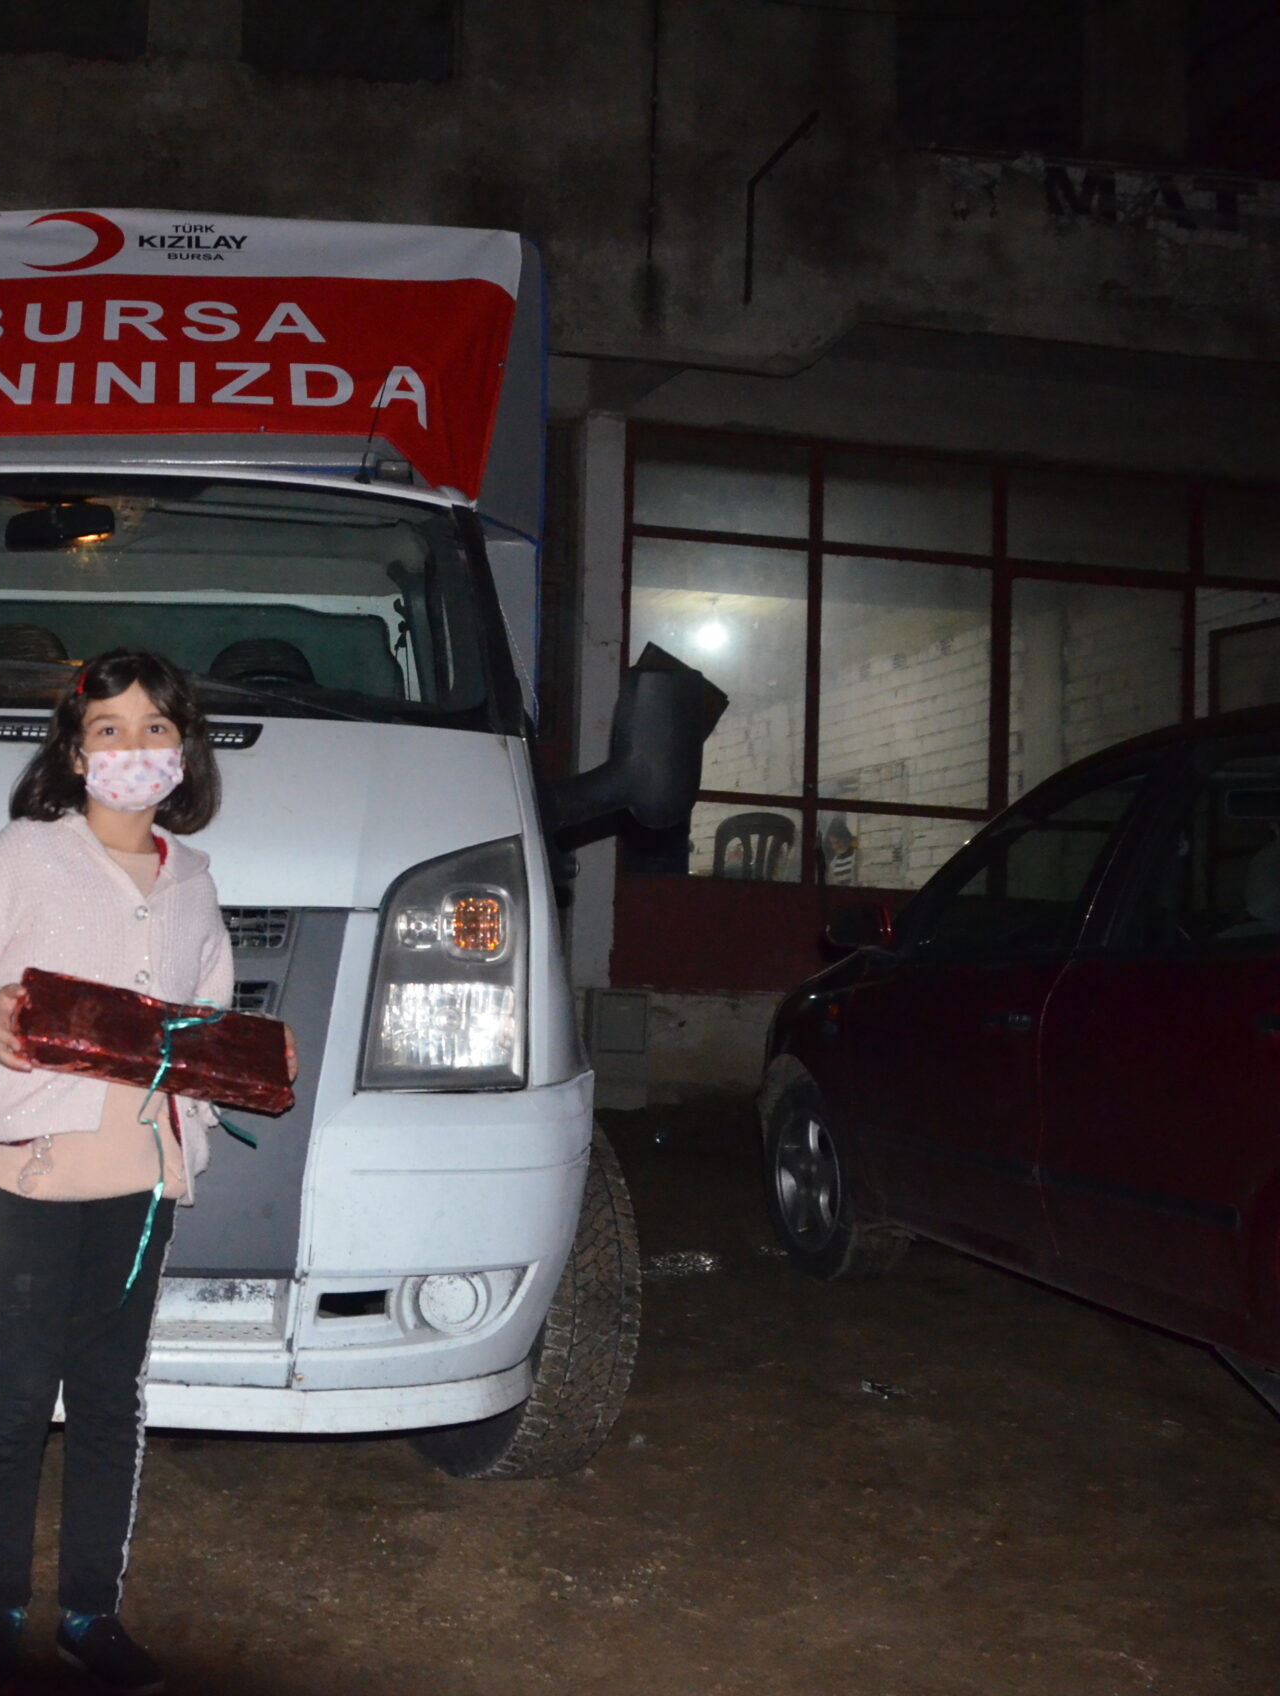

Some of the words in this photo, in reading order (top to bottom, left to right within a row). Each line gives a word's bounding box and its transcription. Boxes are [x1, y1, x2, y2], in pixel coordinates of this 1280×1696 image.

[172, 222, 215, 234] TÜRK
[138, 235, 248, 250] KIZILAY
[167, 252, 224, 261] BURSA
